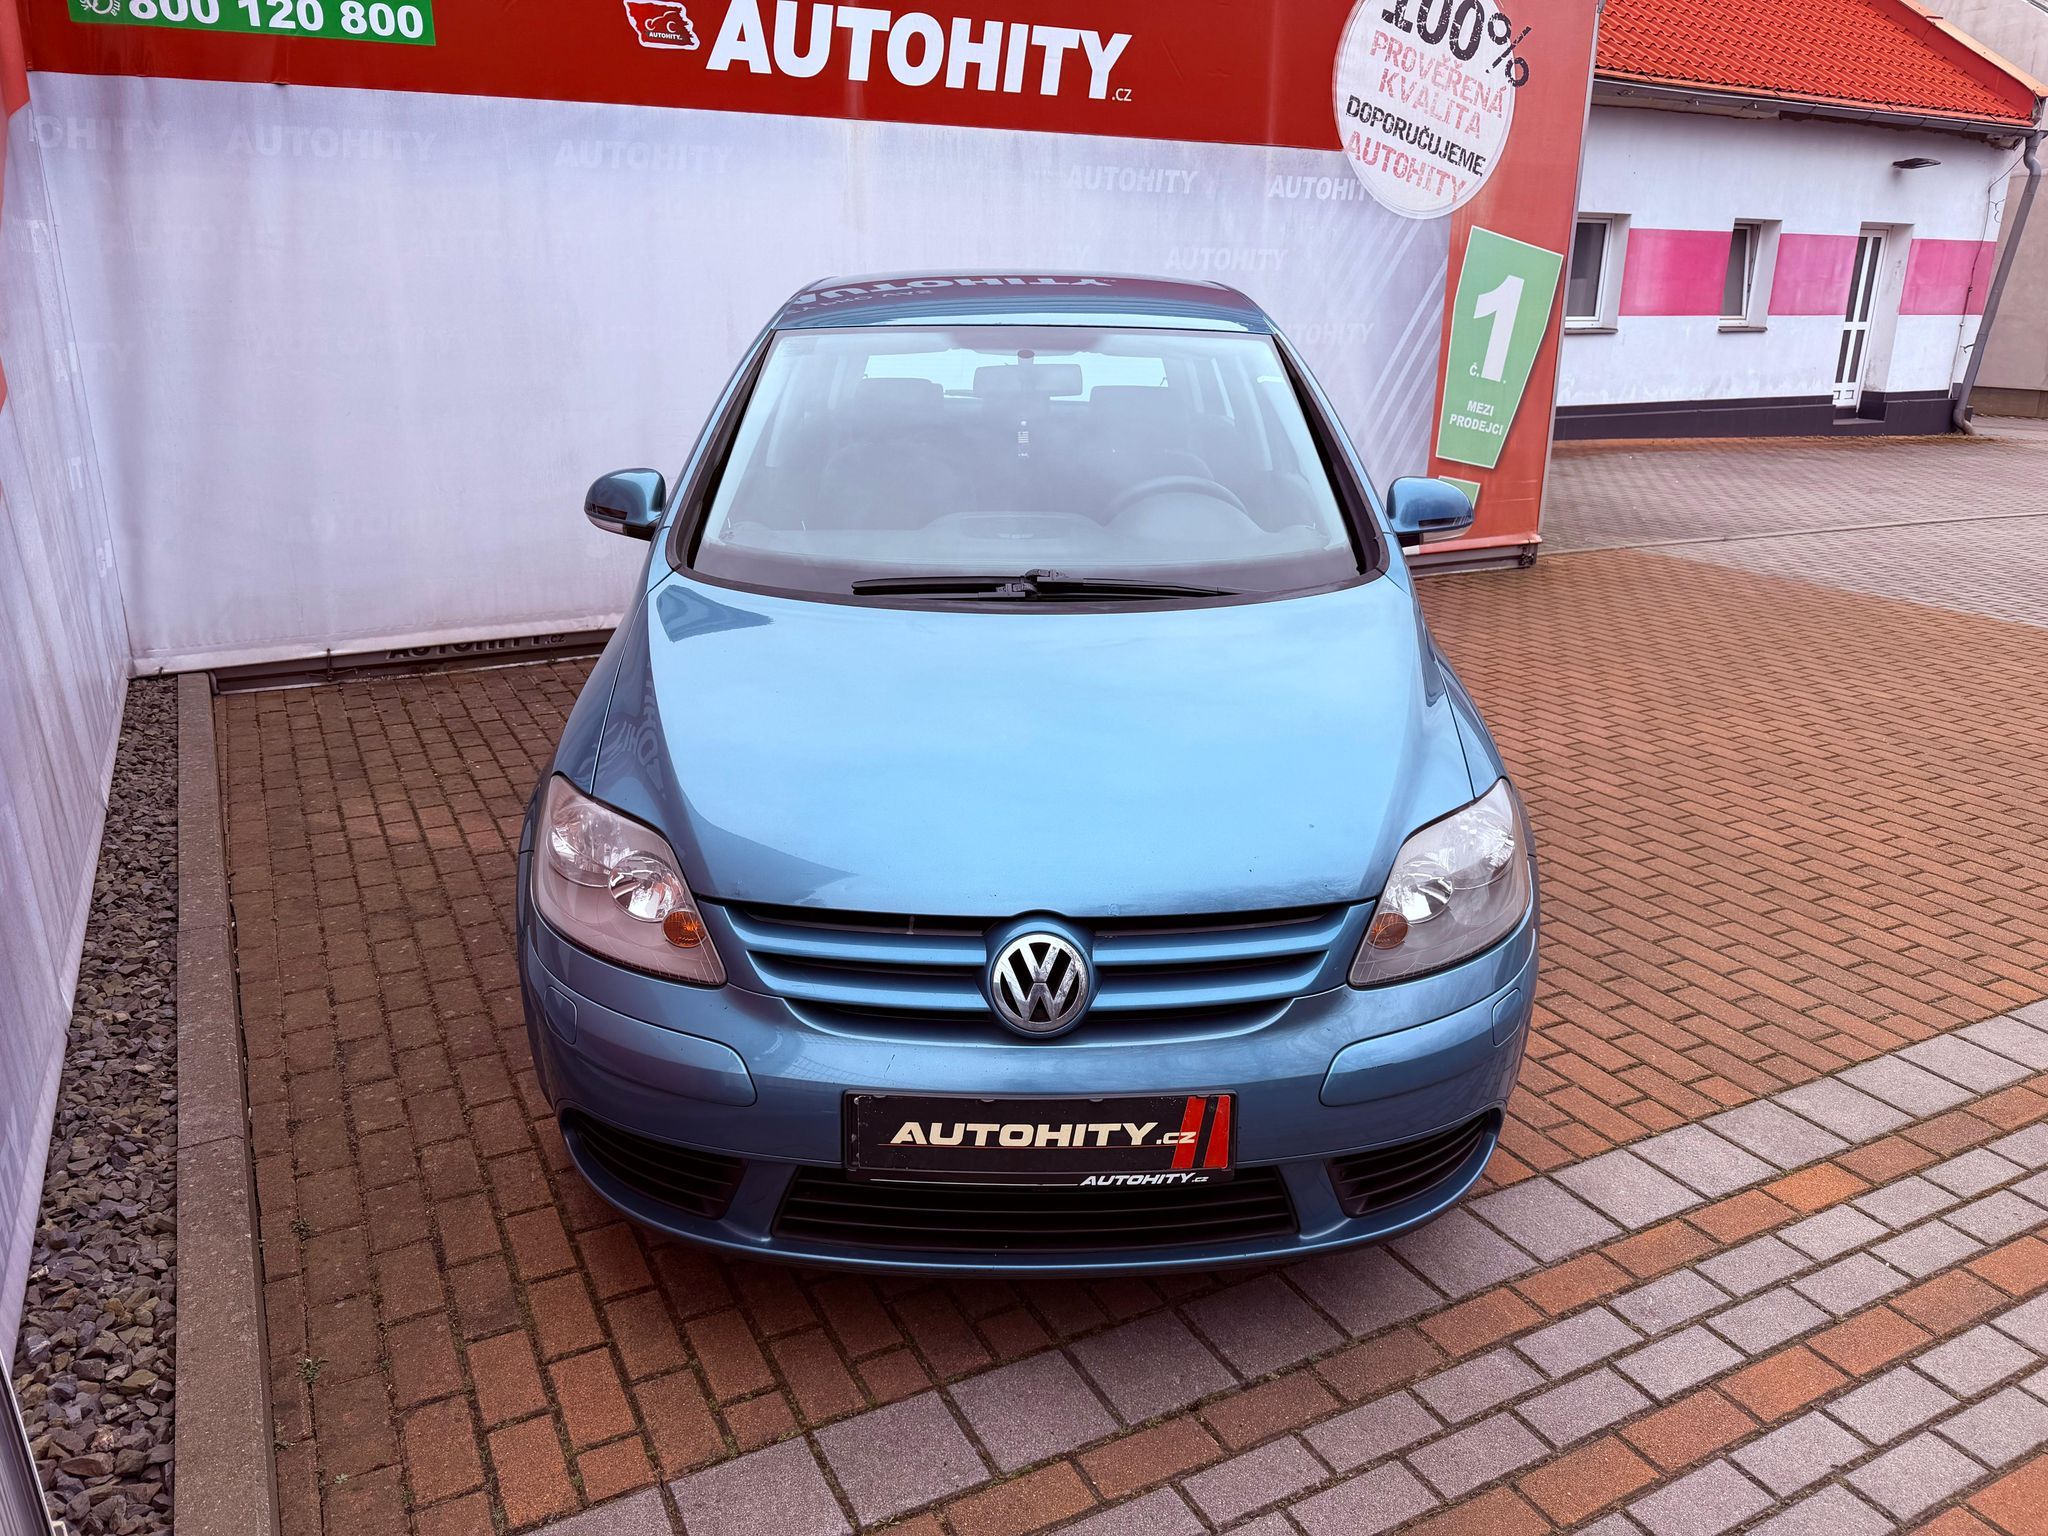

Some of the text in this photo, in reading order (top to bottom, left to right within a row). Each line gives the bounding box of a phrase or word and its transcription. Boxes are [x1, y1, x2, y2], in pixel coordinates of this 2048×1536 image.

[129, 0, 220, 25] 800
[238, 0, 325, 32] 120
[340, 2, 424, 39] 800
[1369, 29, 1507, 119] PROVĚŘENÁ
[1378, 68, 1481, 139] KVALITA
[226, 125, 438, 162] AUTOHITY
[1346, 95, 1486, 177] DOPORUČUJEME
[555, 139, 731, 174] AUTOHITY
[1348, 131, 1467, 204] AUTOHITY
[1067, 164, 1199, 195] AUTOHITY
[1268, 175, 1368, 201] AUTOHIT
[1165, 246, 1287, 272] AUTOHITY
[1449, 413, 1504, 436] PRODEJCI
[1467, 400, 1494, 417] MEZI
